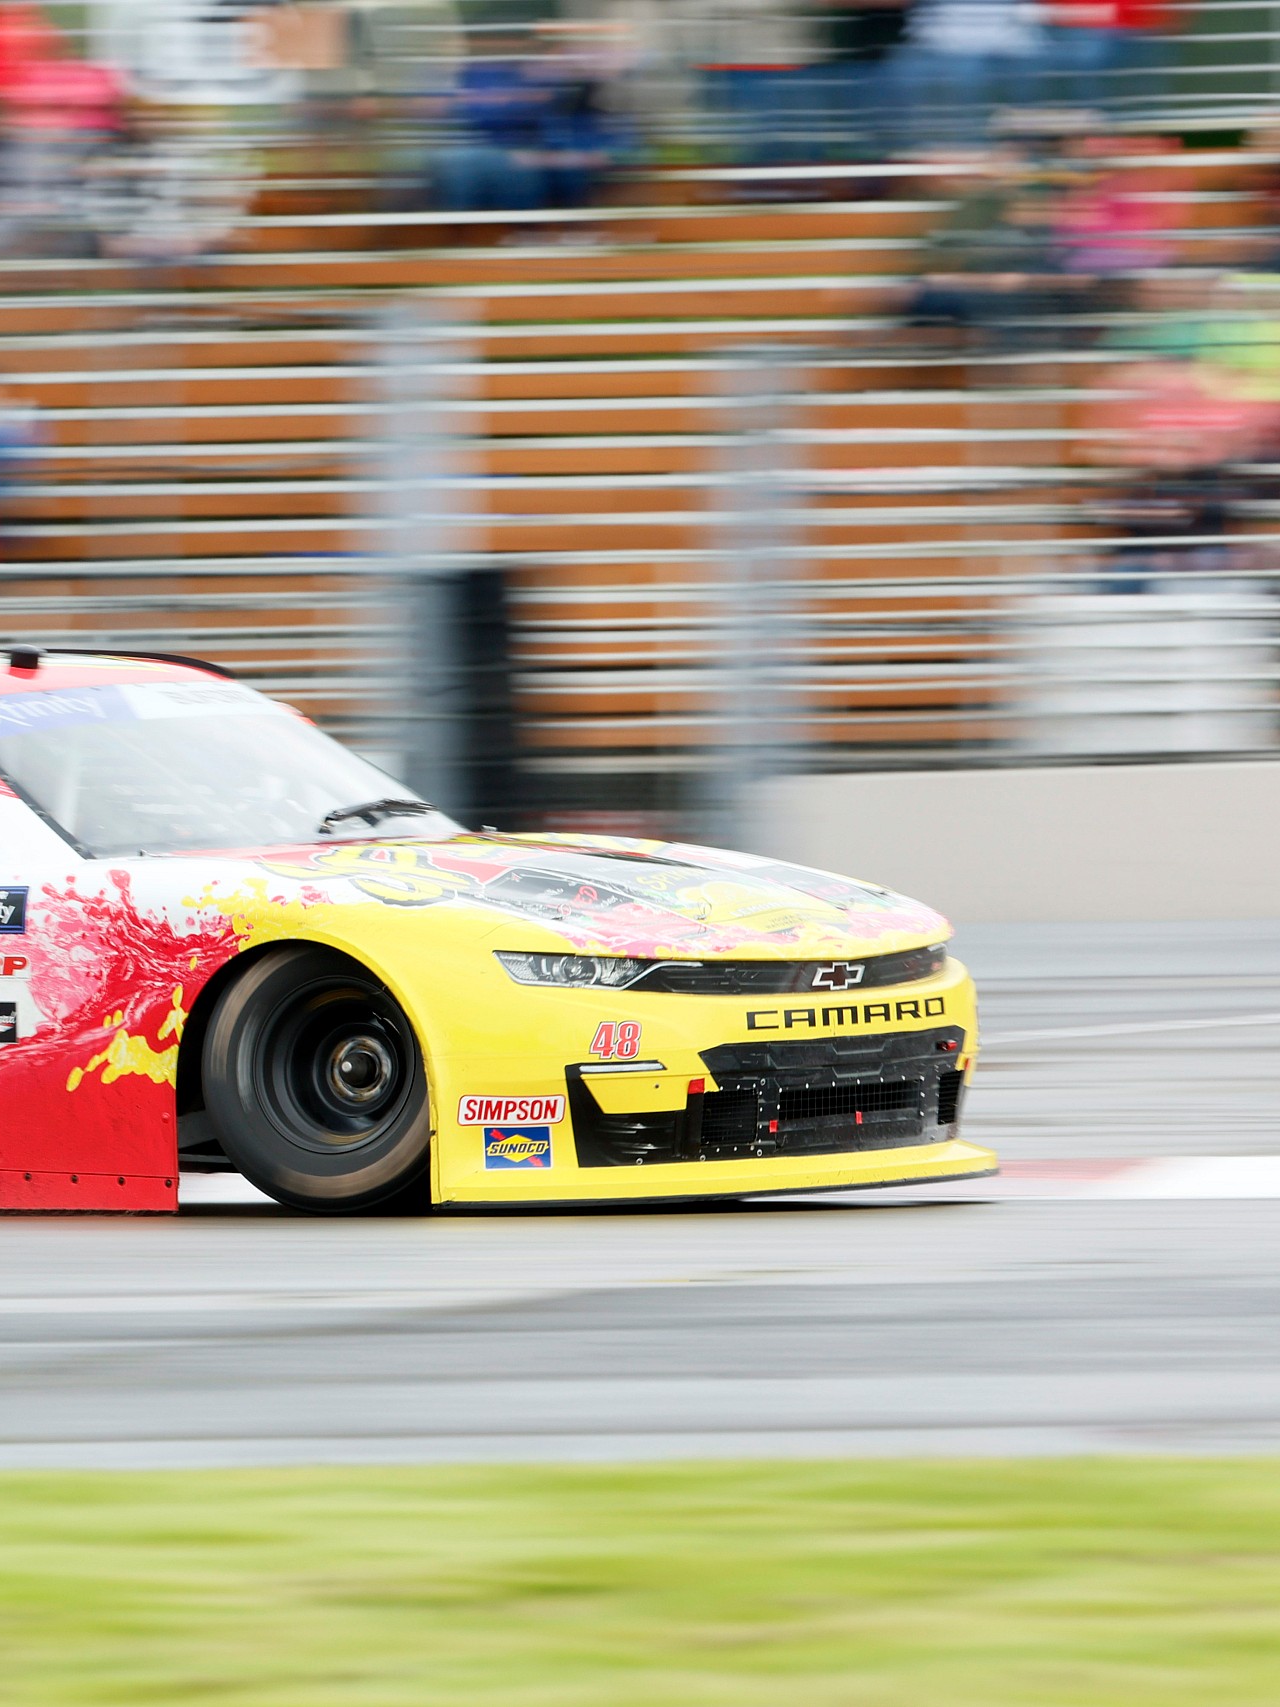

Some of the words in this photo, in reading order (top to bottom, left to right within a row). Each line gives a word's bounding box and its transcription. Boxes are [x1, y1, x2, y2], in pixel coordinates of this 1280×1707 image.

[746, 997, 946, 1031] CAMARO
[589, 1020, 642, 1060] 48
[464, 1099, 559, 1121] SIMPSON
[489, 1142, 546, 1154] SUNOCO
